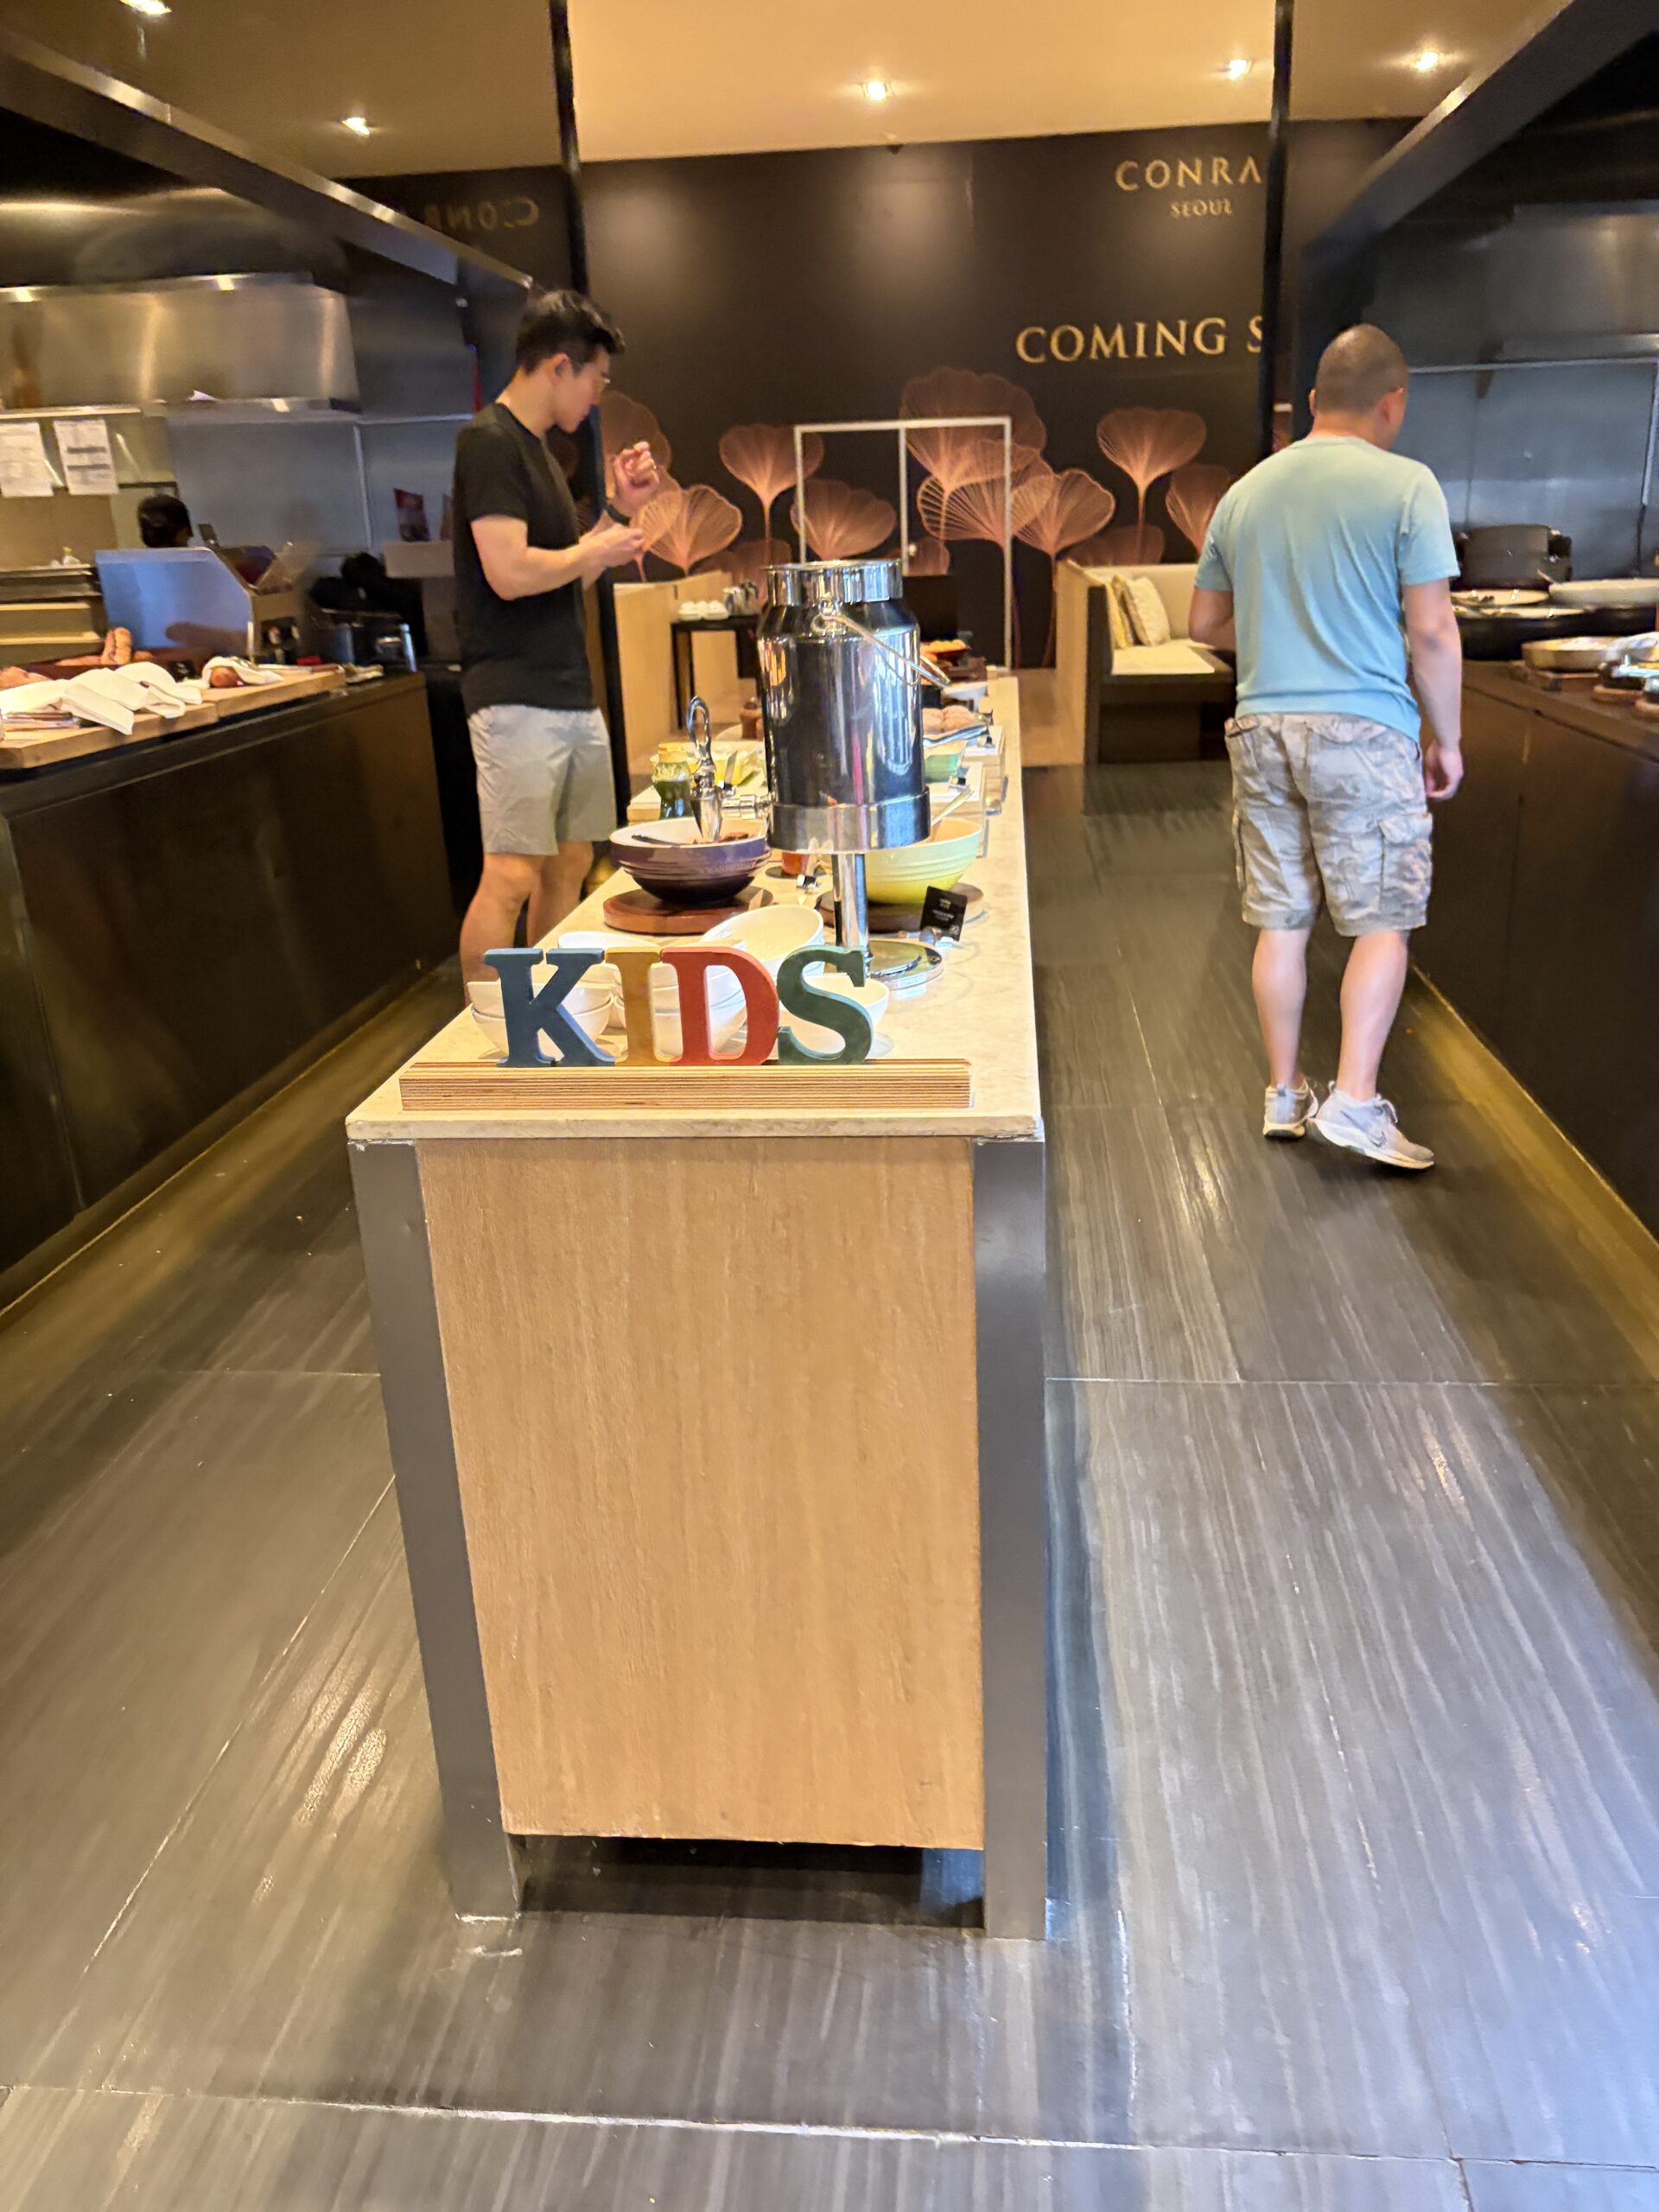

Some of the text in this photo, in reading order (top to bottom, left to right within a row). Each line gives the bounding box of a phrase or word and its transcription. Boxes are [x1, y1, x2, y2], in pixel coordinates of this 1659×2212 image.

[1170, 198, 1233, 218] SEOUL
[1015, 317, 1228, 363] COMING
[483, 944, 873, 1068] KIDS
